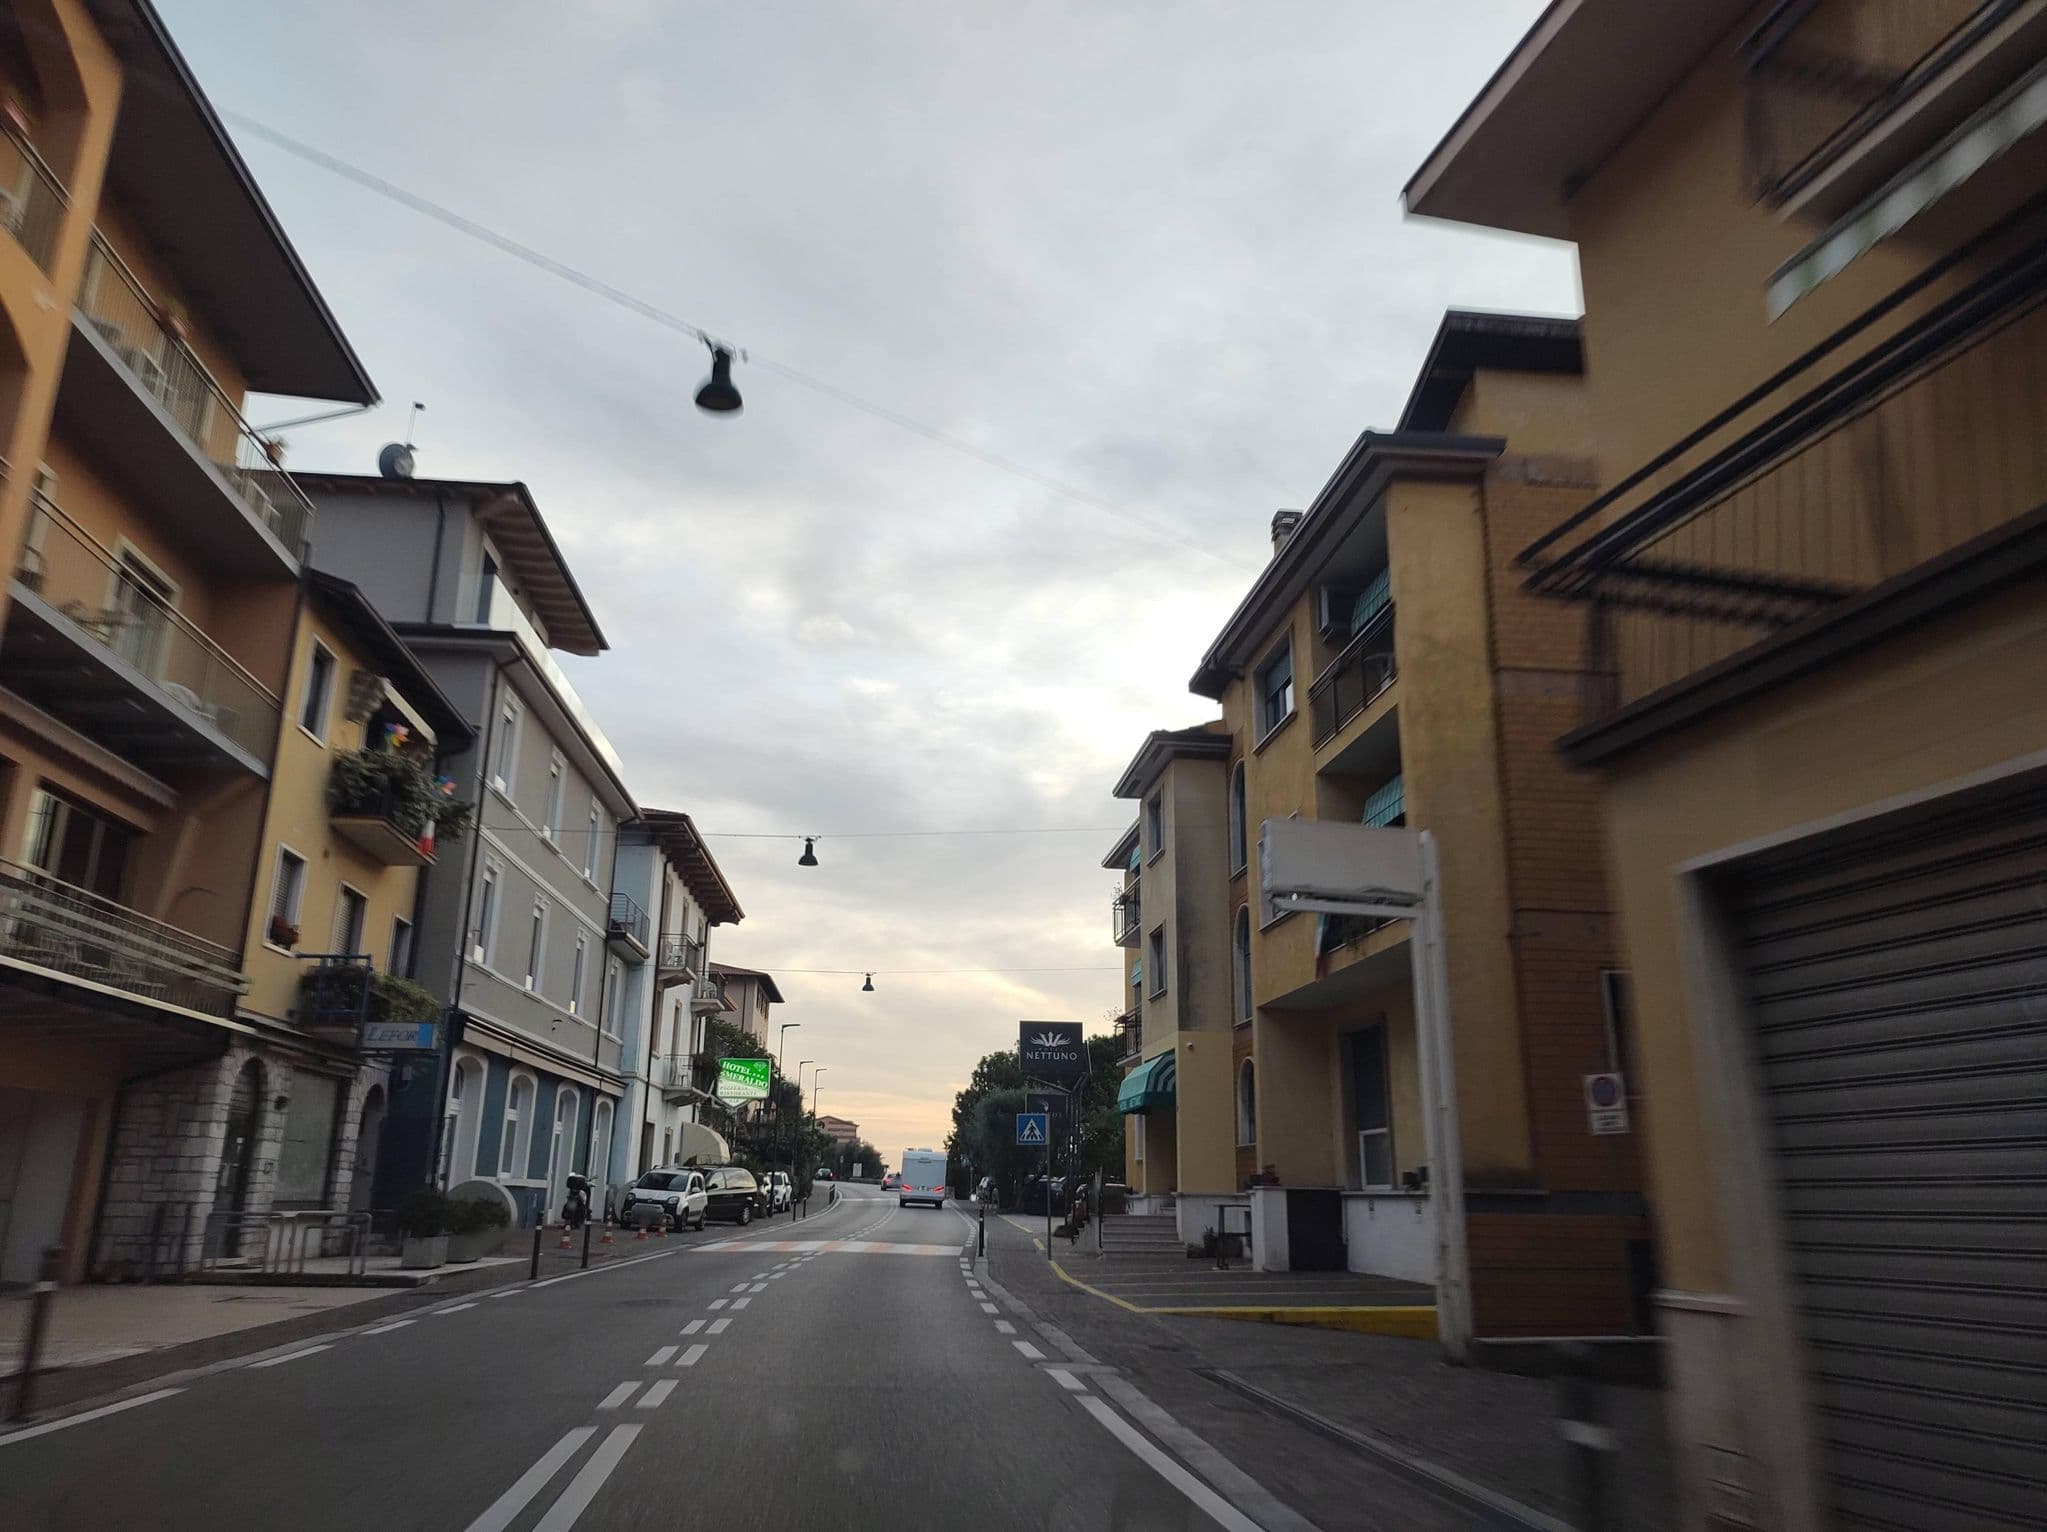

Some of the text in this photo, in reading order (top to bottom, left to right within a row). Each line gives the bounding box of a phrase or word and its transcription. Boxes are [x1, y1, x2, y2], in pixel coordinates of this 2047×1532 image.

[1026, 1051, 1078, 1061] NETTUNO
[722, 1061, 751, 1076] HOTEL
[719, 1070, 768, 1088] SMERALDO
